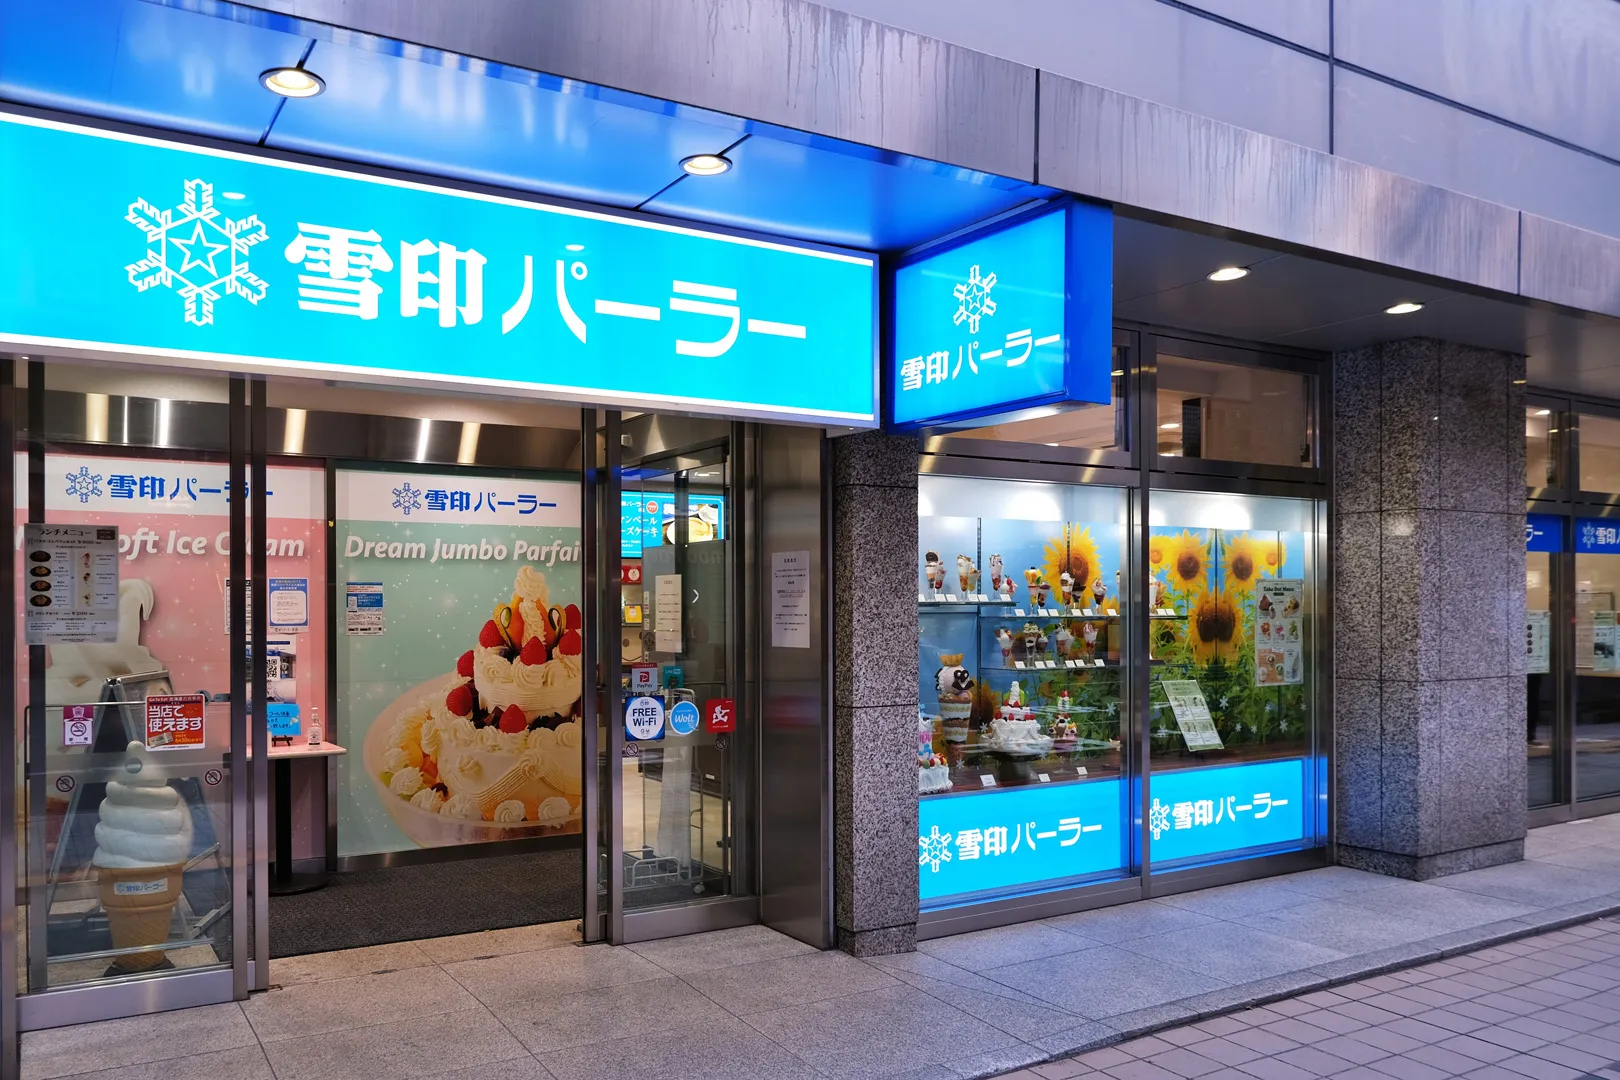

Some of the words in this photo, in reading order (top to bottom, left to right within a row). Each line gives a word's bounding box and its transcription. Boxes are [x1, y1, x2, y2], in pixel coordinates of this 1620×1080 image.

[284, 222, 807, 358] 雪印パーラー
[900, 328, 1061, 391] 雪印パーラー
[425, 489, 557, 514] 雪印パーラー
[118, 527, 159, 560] oft
[166, 530, 207, 555] Ice
[215, 531, 305, 557] Cam
[1595, 527, 1620, 545] 雪印
[344, 535, 426, 559] Dream
[430, 538, 508, 563] Jumbo
[513, 540, 582, 567] Parfai
[149, 705, 184, 718] 当店で
[632, 707, 657, 717] FREE
[632, 717, 657, 727] Wi-Fi
[674, 714, 695, 724] Wolt
[149, 717, 202, 732] 使えます
[1172, 792, 1288, 831] 雪印パーラー
[955, 816, 1102, 861] 雪印パーラー
